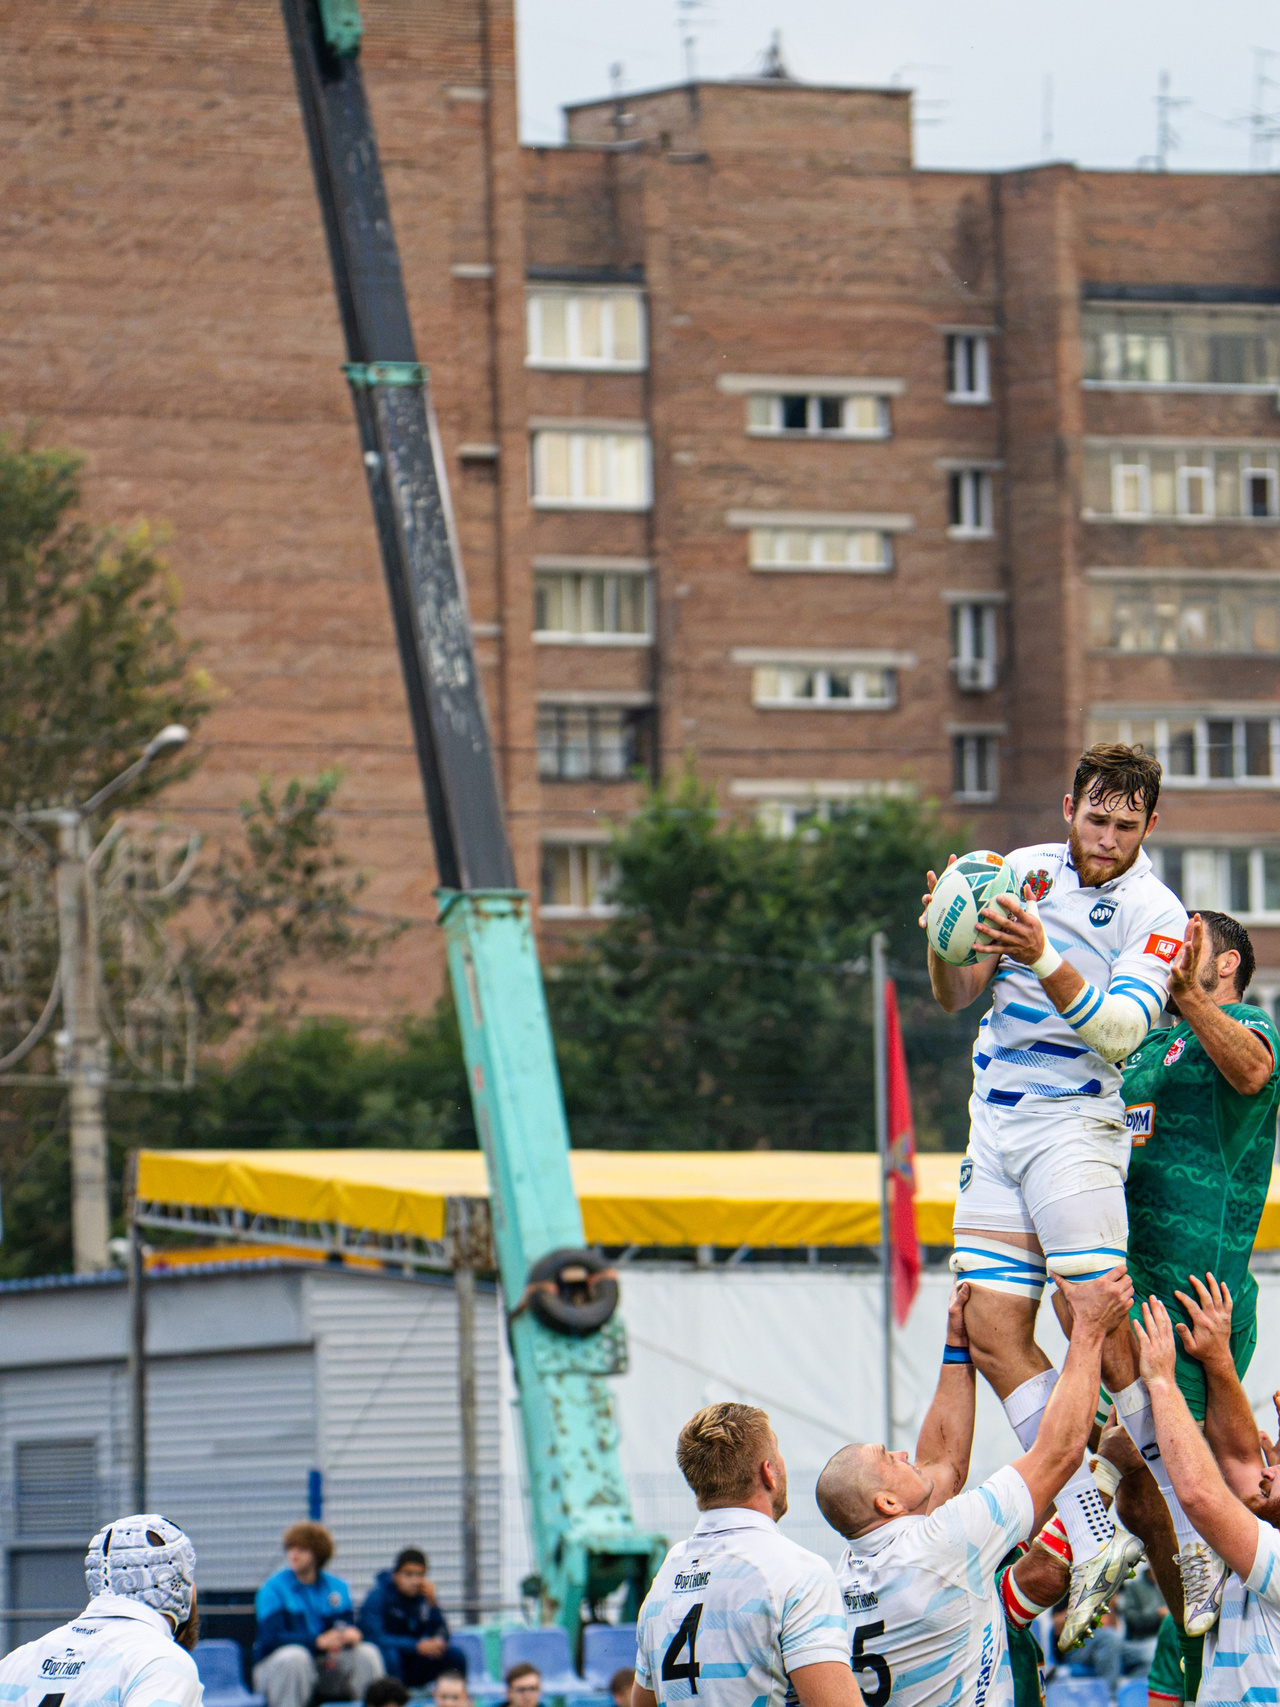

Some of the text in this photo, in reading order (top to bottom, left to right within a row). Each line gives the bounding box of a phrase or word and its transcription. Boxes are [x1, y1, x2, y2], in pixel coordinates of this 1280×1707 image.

[937, 894, 967, 951] СИБУР
[72, 1626, 99, 1635] centuri
[662, 1603, 704, 1695] 4
[850, 1620, 892, 1707] 5
